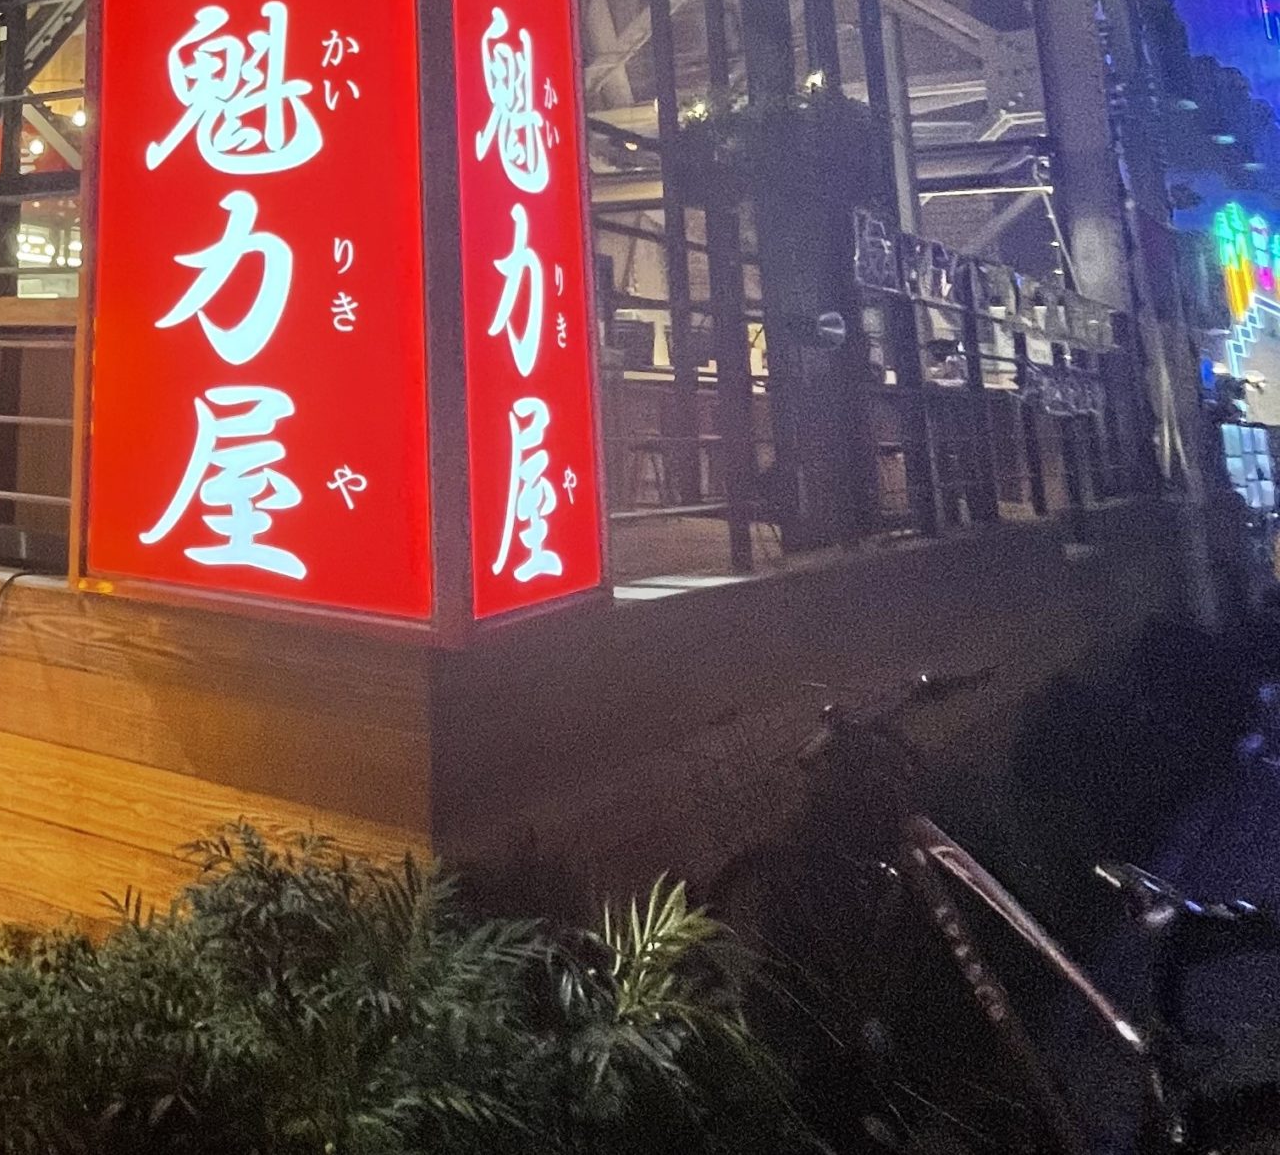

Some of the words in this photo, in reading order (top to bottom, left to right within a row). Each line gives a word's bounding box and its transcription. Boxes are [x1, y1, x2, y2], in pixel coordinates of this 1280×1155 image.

[320, 30, 360, 111] かい
[541, 77, 560, 147] かい
[331, 236, 359, 333] りき
[554, 263, 568, 349] りき
[326, 465, 368, 511] や
[562, 466, 577, 505] や
